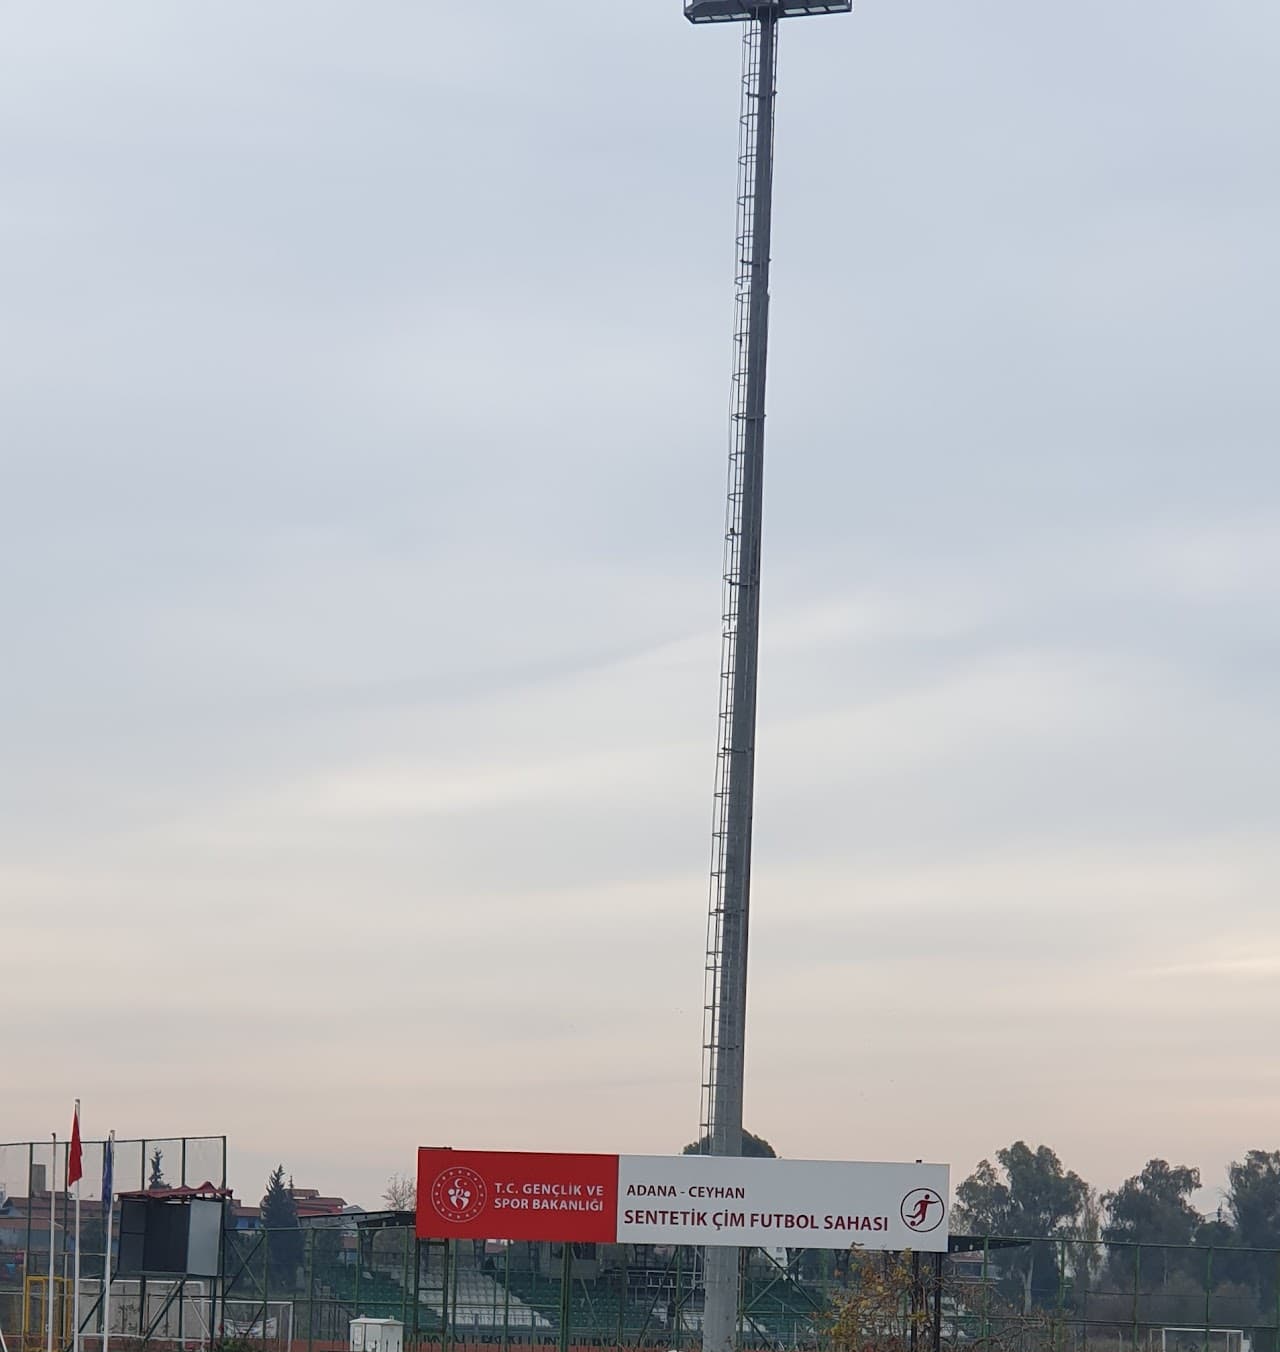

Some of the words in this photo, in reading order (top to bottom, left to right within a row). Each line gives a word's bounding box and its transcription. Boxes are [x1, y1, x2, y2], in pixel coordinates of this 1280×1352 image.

[494, 1183, 519, 1194] T.C.
[522, 1183, 582, 1197] GENÇLİK
[586, 1186, 604, 1196] VE
[626, 1184, 677, 1197] ADANA
[688, 1186, 745, 1199] CEYHAN
[494, 1198, 529, 1209] SPOR
[532, 1198, 604, 1211] BAKANLIĞI
[624, 1208, 708, 1226] SENTETİK
[712, 1209, 745, 1231] ÇİM
[750, 1213, 819, 1229] FUTBOL
[823, 1215, 888, 1231] SAHASI
